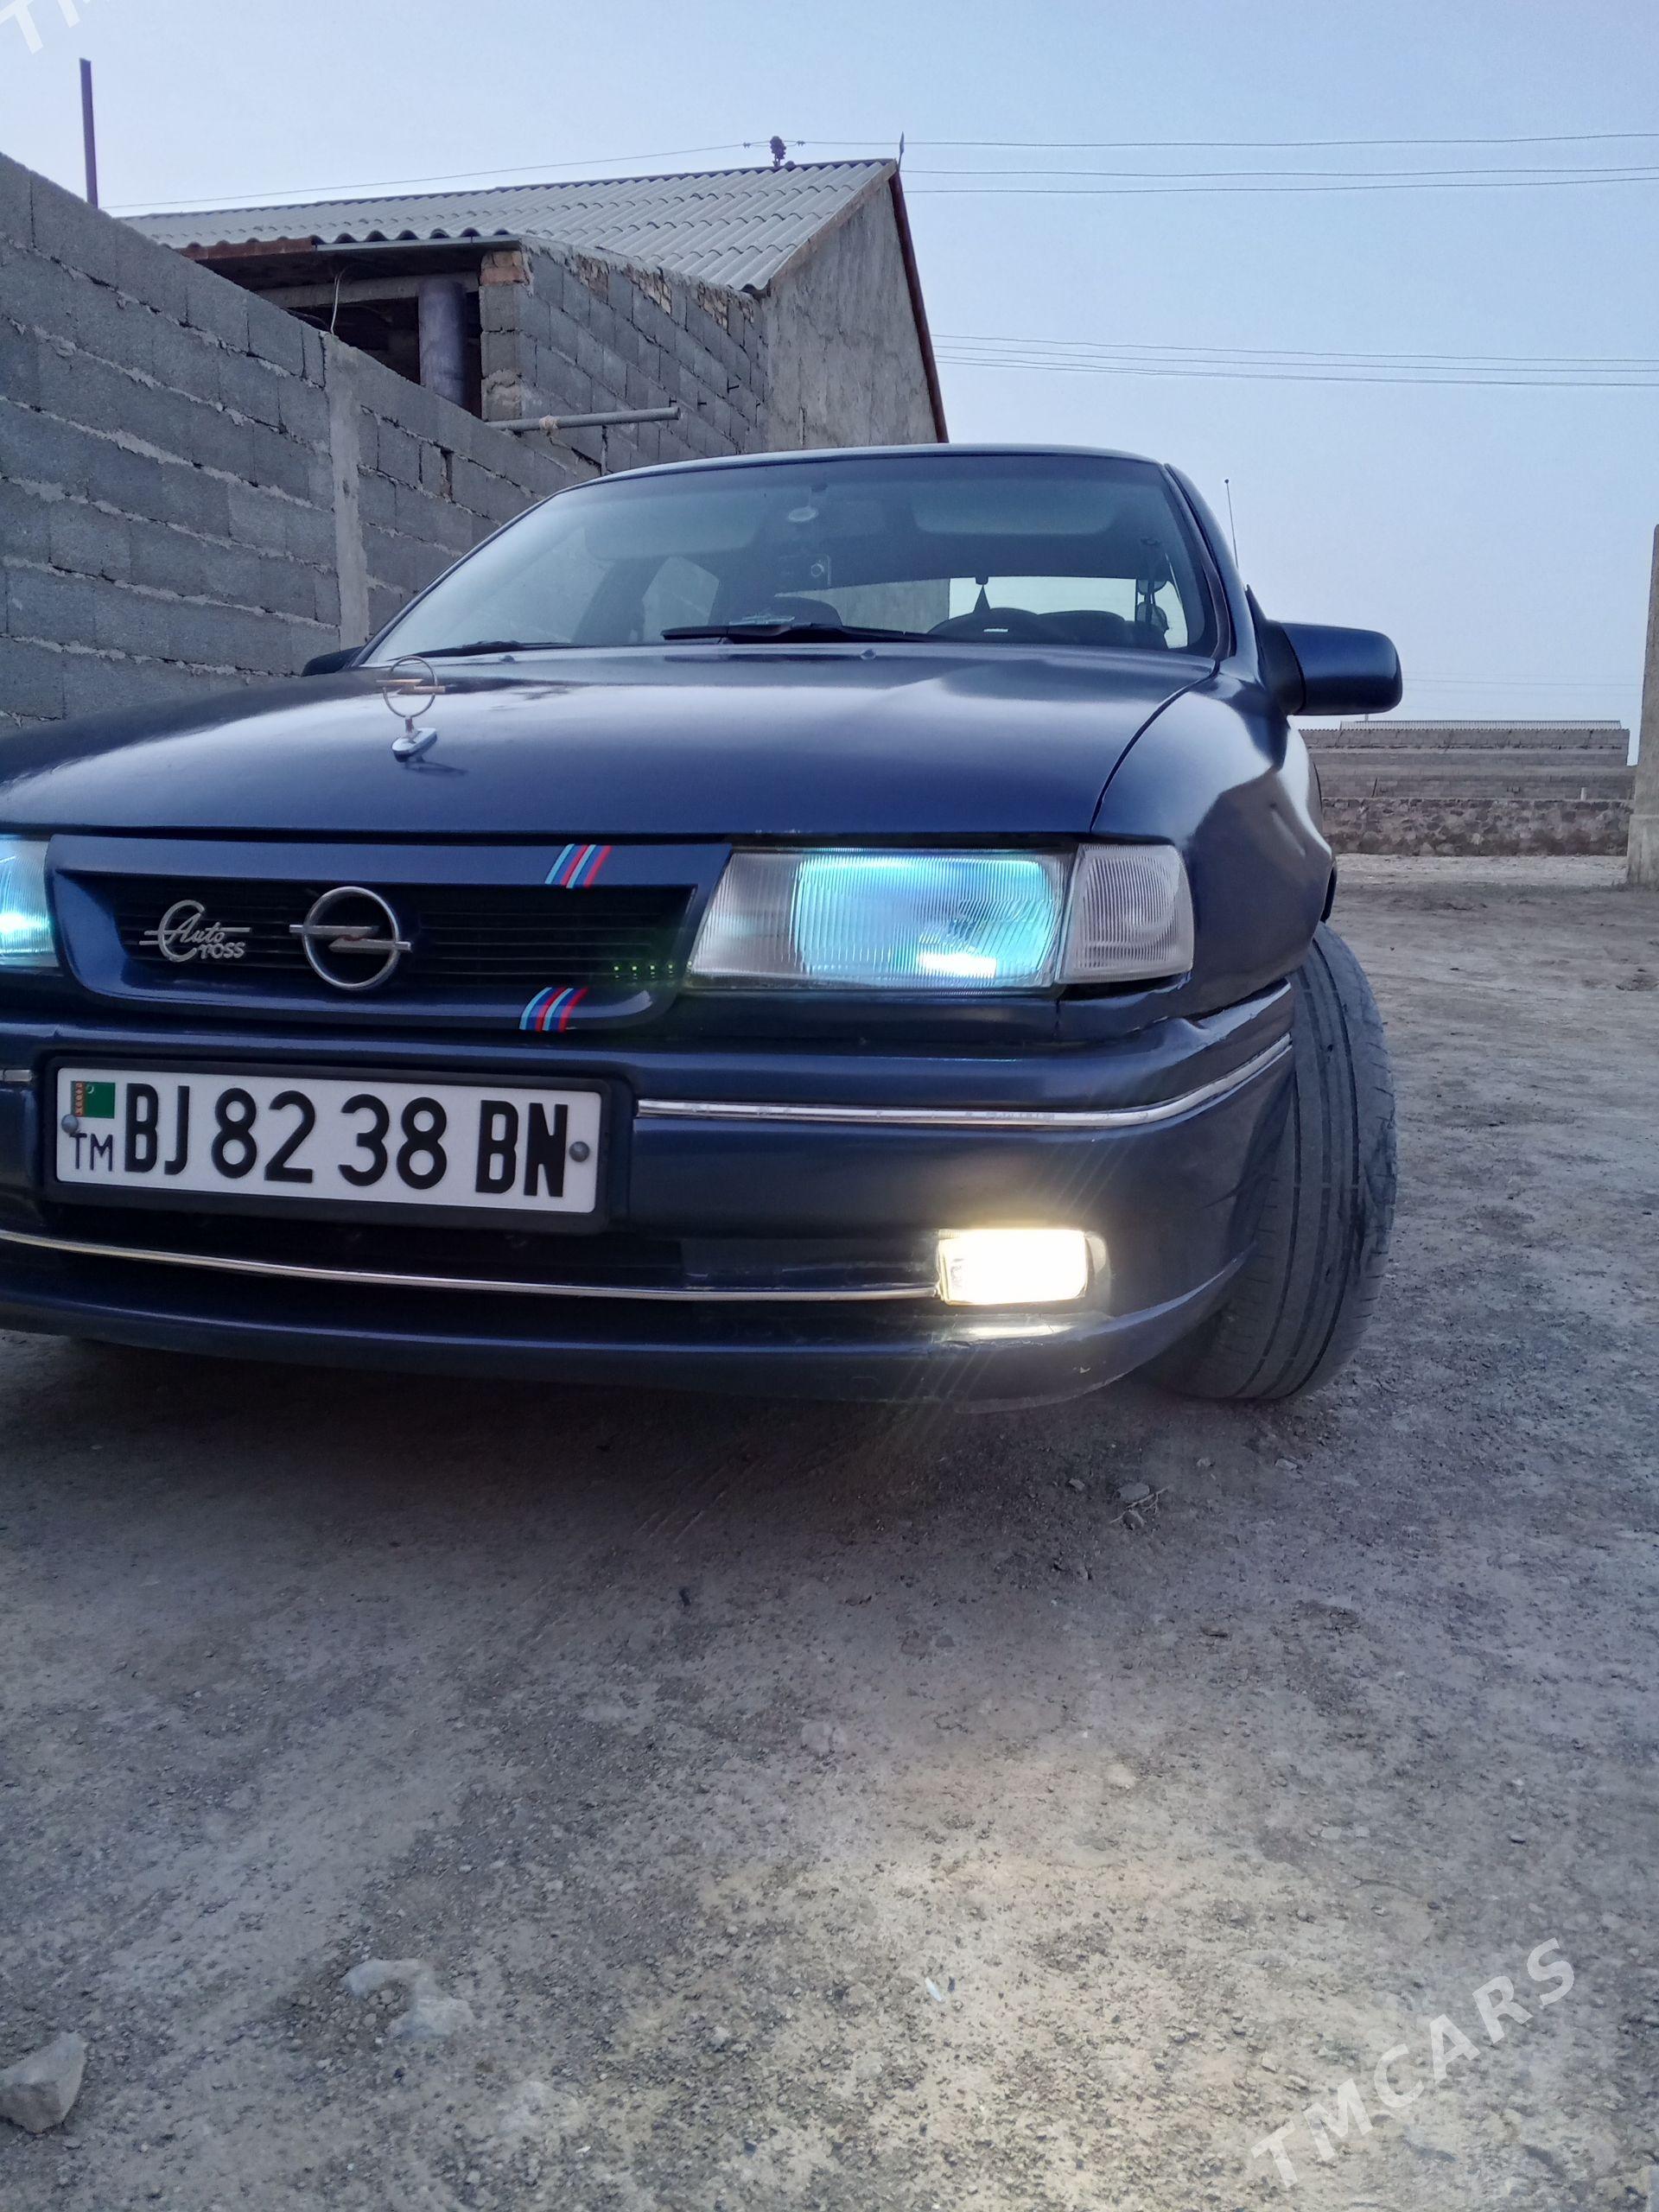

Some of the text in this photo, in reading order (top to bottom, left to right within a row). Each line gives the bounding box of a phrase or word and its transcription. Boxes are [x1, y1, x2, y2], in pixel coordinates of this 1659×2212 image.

[157, 912, 226, 944] Auto
[157, 899, 246, 963] Cross
[70, 1133, 113, 1172] TM
[475, 1100, 569, 1198] BN
